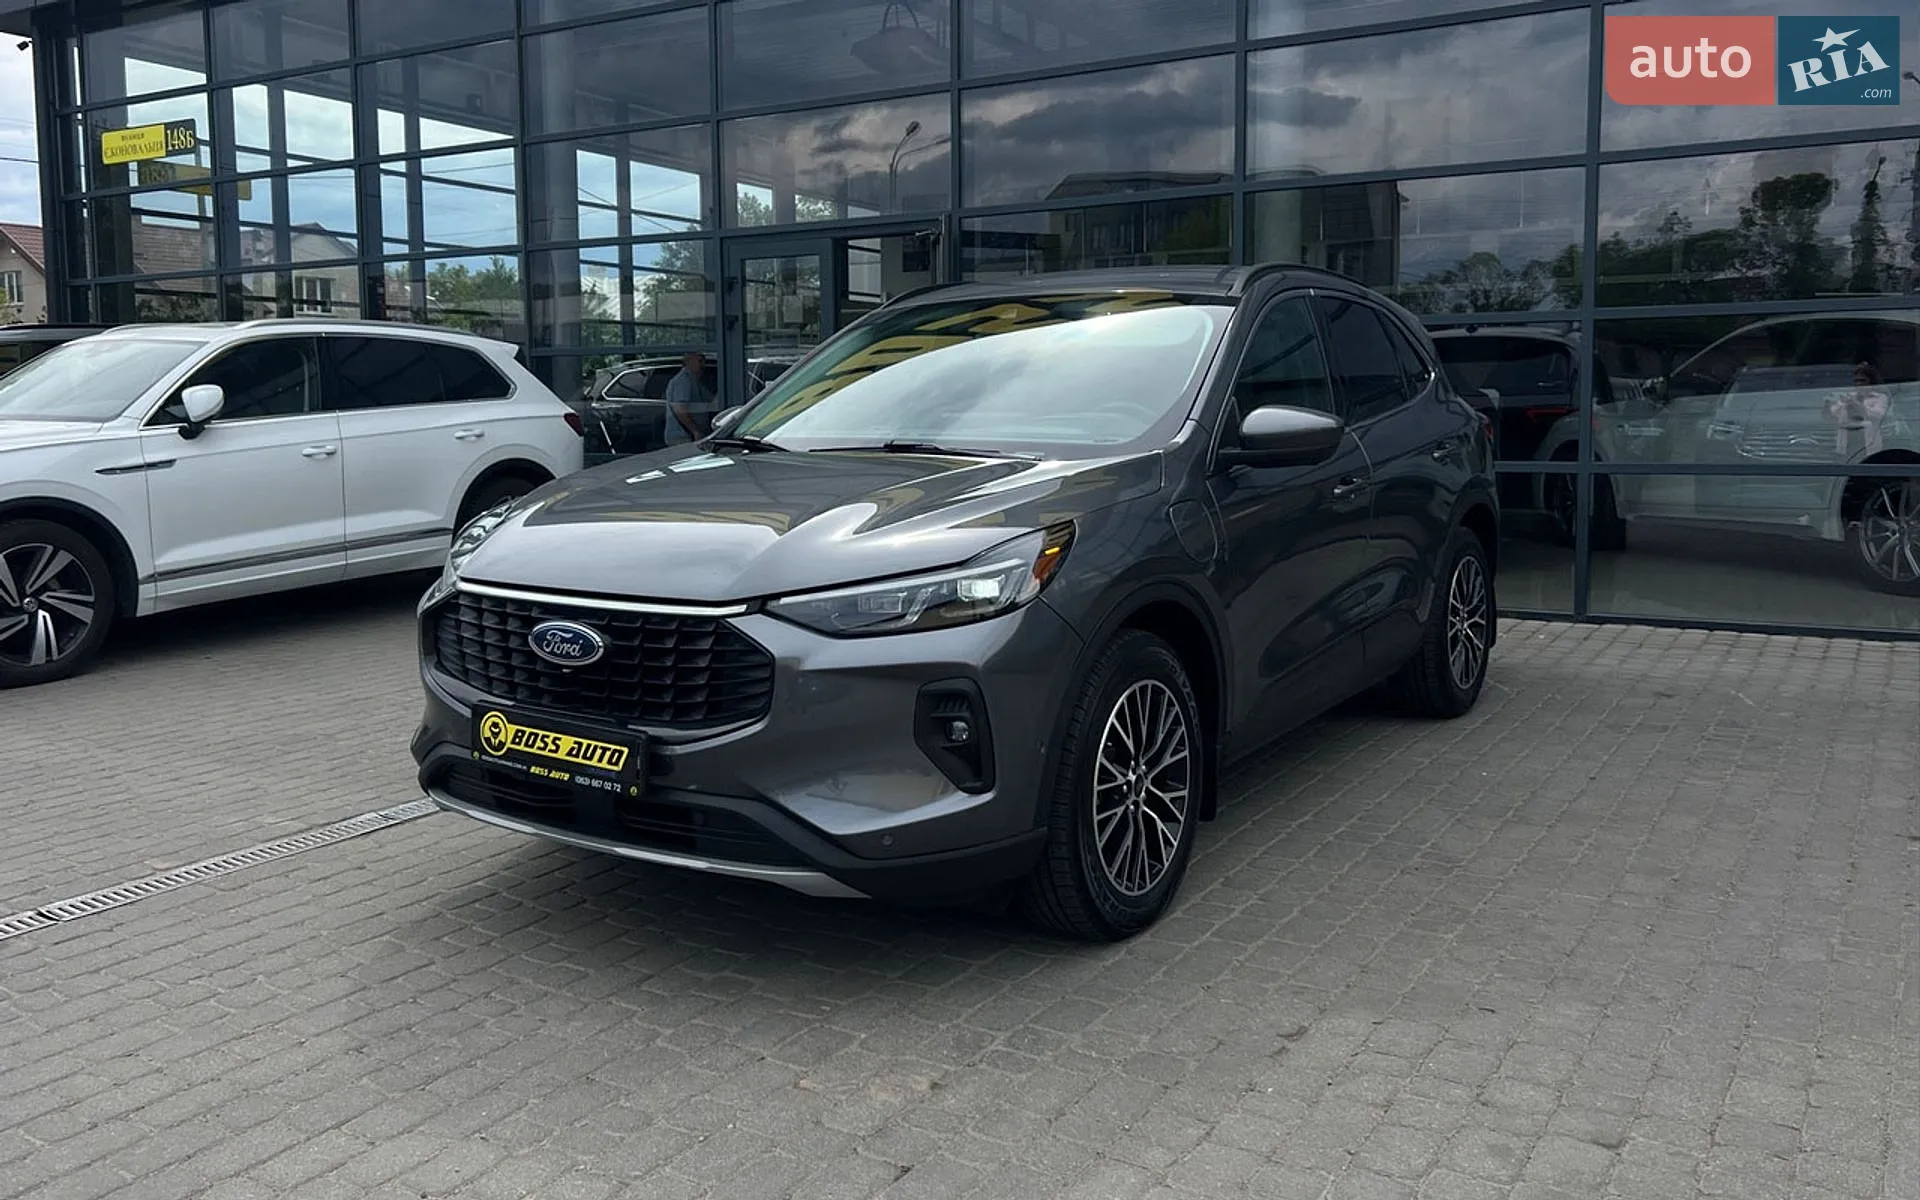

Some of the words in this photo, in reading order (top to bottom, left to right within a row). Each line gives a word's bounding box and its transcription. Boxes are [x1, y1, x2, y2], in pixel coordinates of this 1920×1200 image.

[166, 126, 195, 150] 148Б
[542, 629, 584, 657] Ford
[510, 728, 563, 754] BOSS
[566, 741, 625, 767] AUTO
[530, 765, 549, 777] BOSS
[549, 770, 570, 781] AUTO
[613, 782, 622, 793] 72
